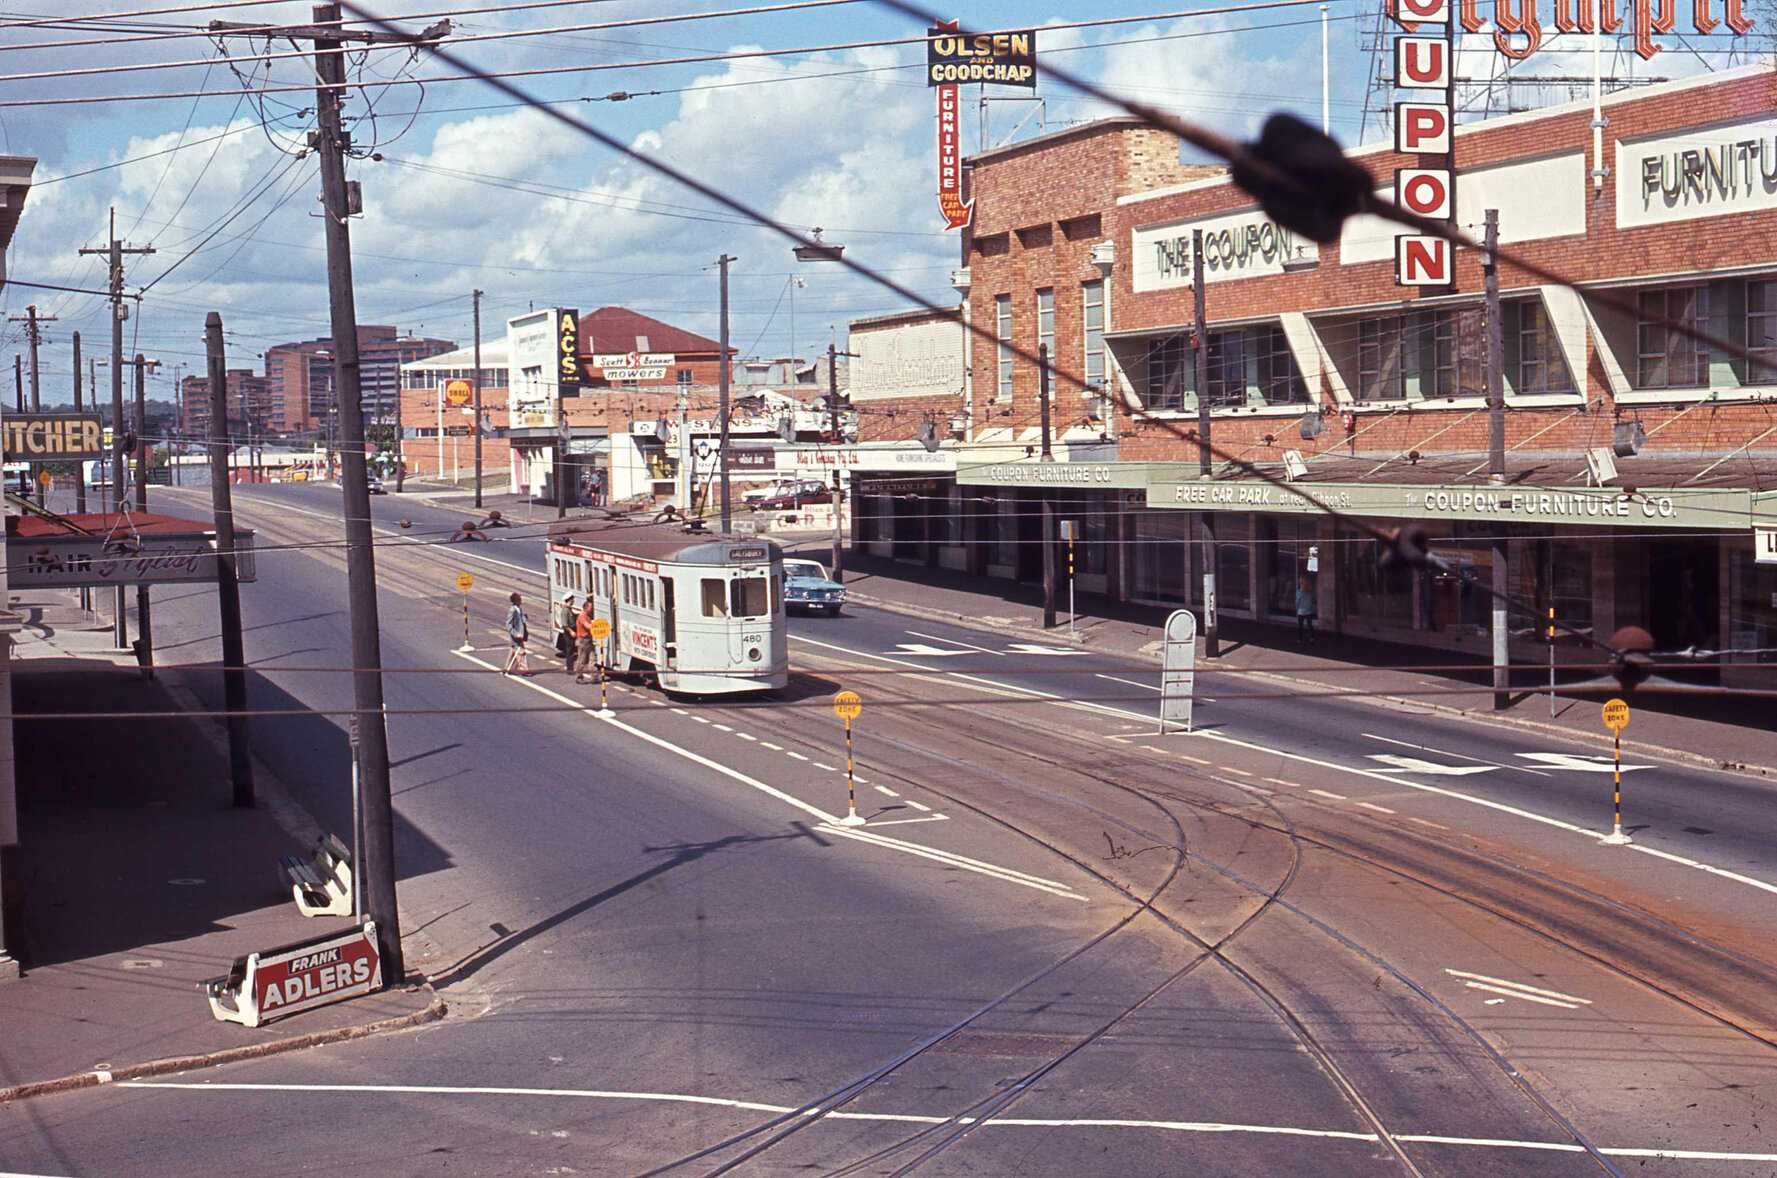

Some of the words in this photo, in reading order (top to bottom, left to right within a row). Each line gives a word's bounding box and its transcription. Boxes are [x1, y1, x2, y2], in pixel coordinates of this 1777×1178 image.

[933, 34, 1029, 57] OLSEN
[931, 64, 1033, 82] GOODCHAP
[942, 89, 956, 189] FURNITURE
[943, 202, 959, 210] CAR
[946, 210, 968, 218] PARK
[1154, 236, 1191, 276] THE
[1205, 219, 1293, 268] COUPON
[601, 357, 624, 366] Scott
[607, 369, 664, 379] mowers
[449, 389, 470, 397] SHELL
[991, 466, 1029, 481] COUPON
[1033, 467, 1090, 482] FURNITURE
[1175, 486, 1207, 502] FREE
[1211, 487, 1234, 503] CAR
[1238, 487, 1271, 505] PARK
[1290, 493, 1309, 506] rea
[1424, 492, 1499, 512] COUPON
[1511, 494, 1630, 516] FURNITURE
[1642, 496, 1677, 518] CO.
[1768, 533, 1777, 552] L
[28, 553, 92, 573] HAIR
[743, 635, 762, 643] 480
[1604, 704, 1628, 713] SAFETY
[291, 948, 339, 973] FRANK
[262, 957, 371, 1010] ADLERS
